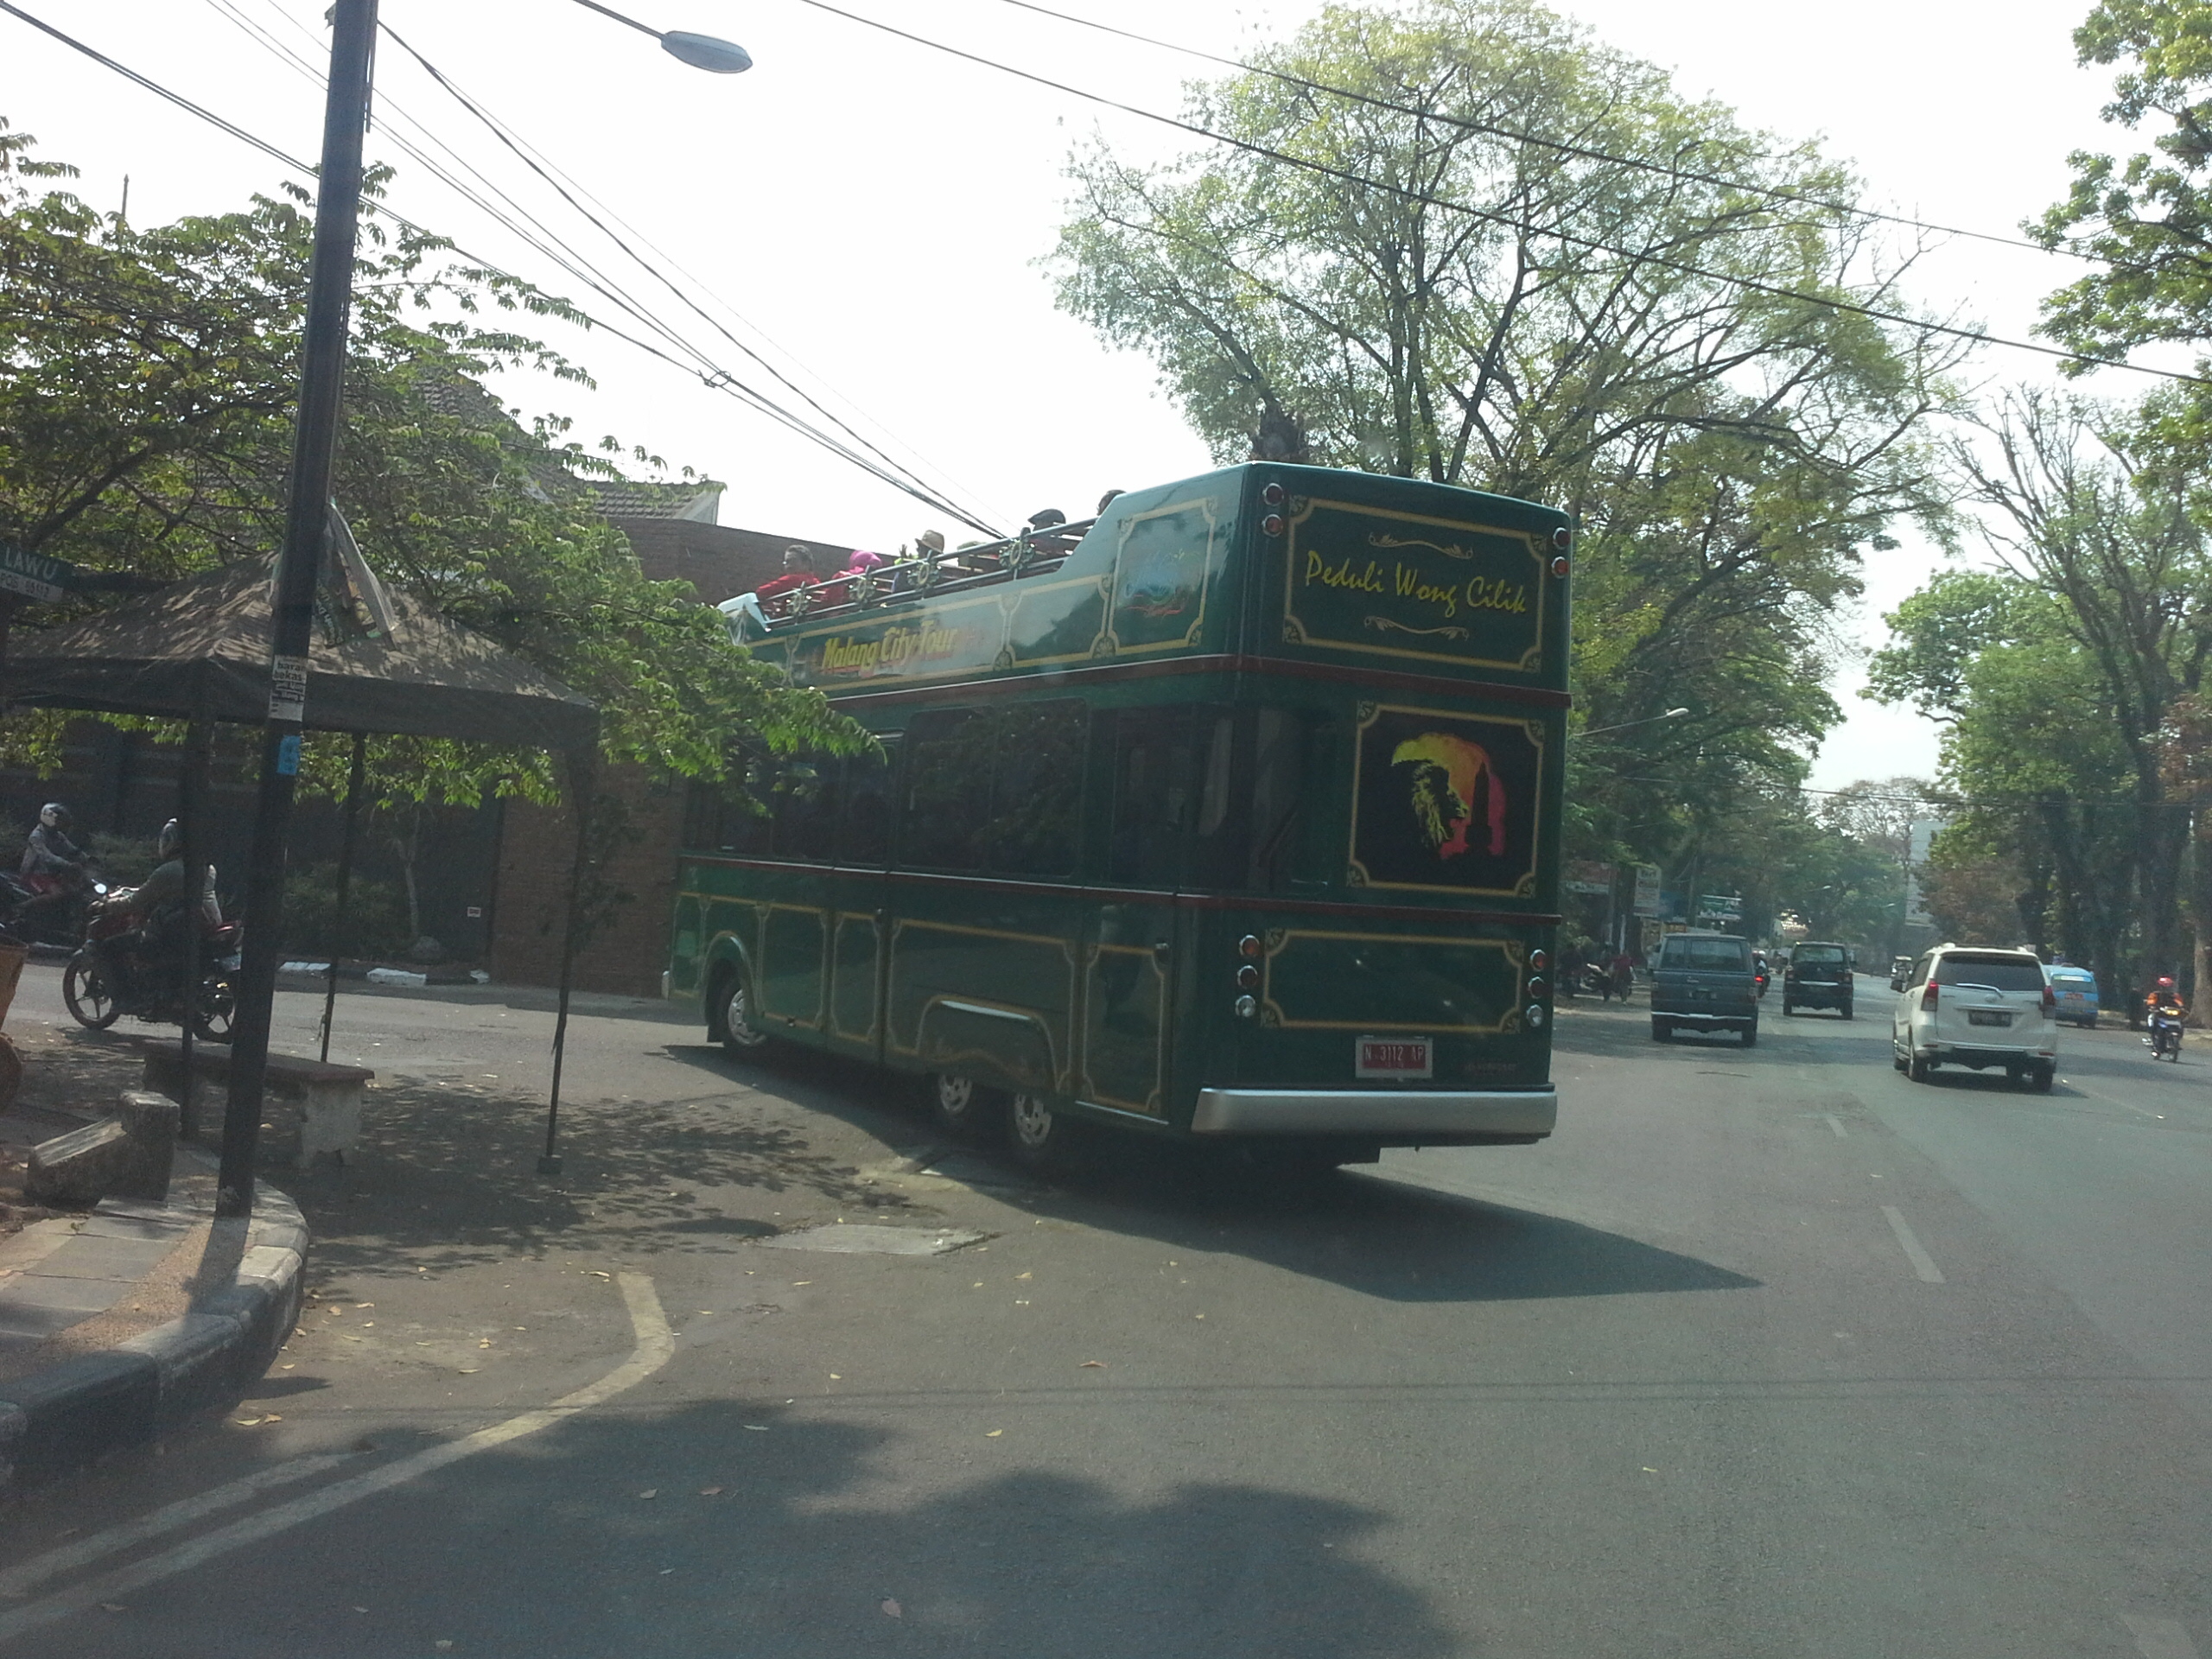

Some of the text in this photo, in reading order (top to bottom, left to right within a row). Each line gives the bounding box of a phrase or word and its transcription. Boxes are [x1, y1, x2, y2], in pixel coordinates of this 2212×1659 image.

[4, 546, 60, 581] LAWU
[1305, 550, 1527, 619] Peduli Wong Cilik
[822, 620, 958, 671] Malang City Tour
[1365, 1045, 1372, 1061] N
[1380, 1045, 1404, 1062] 3112
